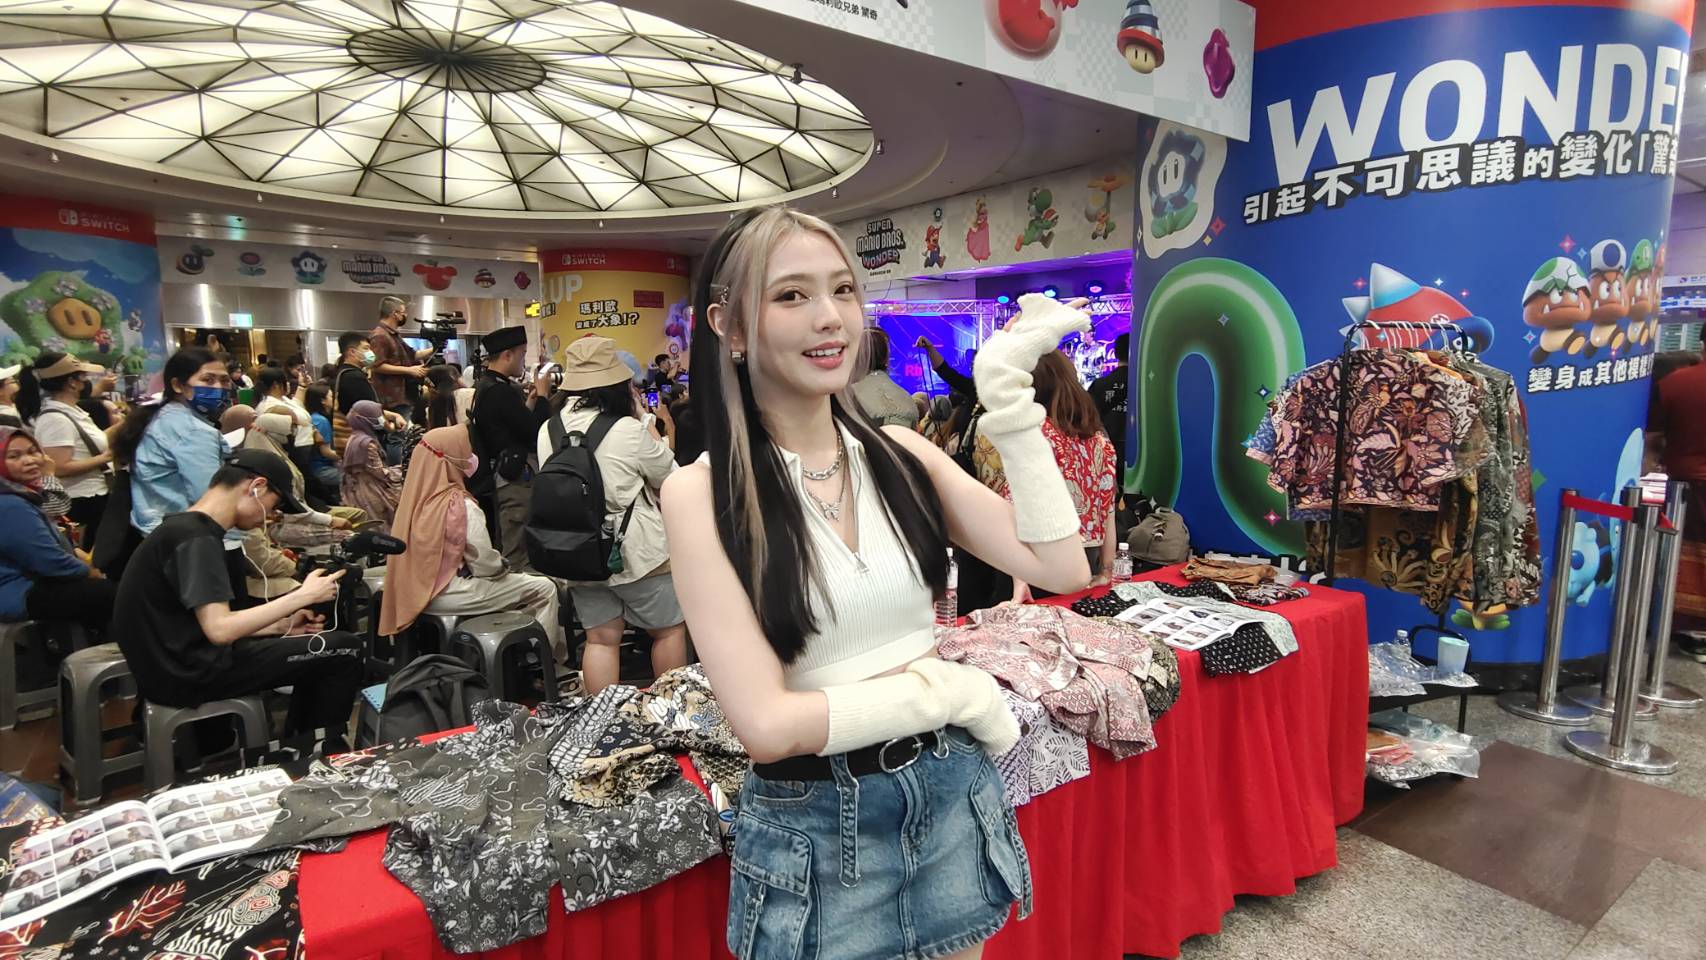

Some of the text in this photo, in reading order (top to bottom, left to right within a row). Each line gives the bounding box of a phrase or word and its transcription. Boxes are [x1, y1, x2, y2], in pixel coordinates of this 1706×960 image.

[1267, 43, 1688, 183] WONDE
[80, 217, 130, 233] SWITCH
[867, 219, 892, 234] SUPER
[857, 234, 881, 254] MARIO
[571, 257, 607, 266] SWITCH
[863, 250, 899, 268] WONDER
